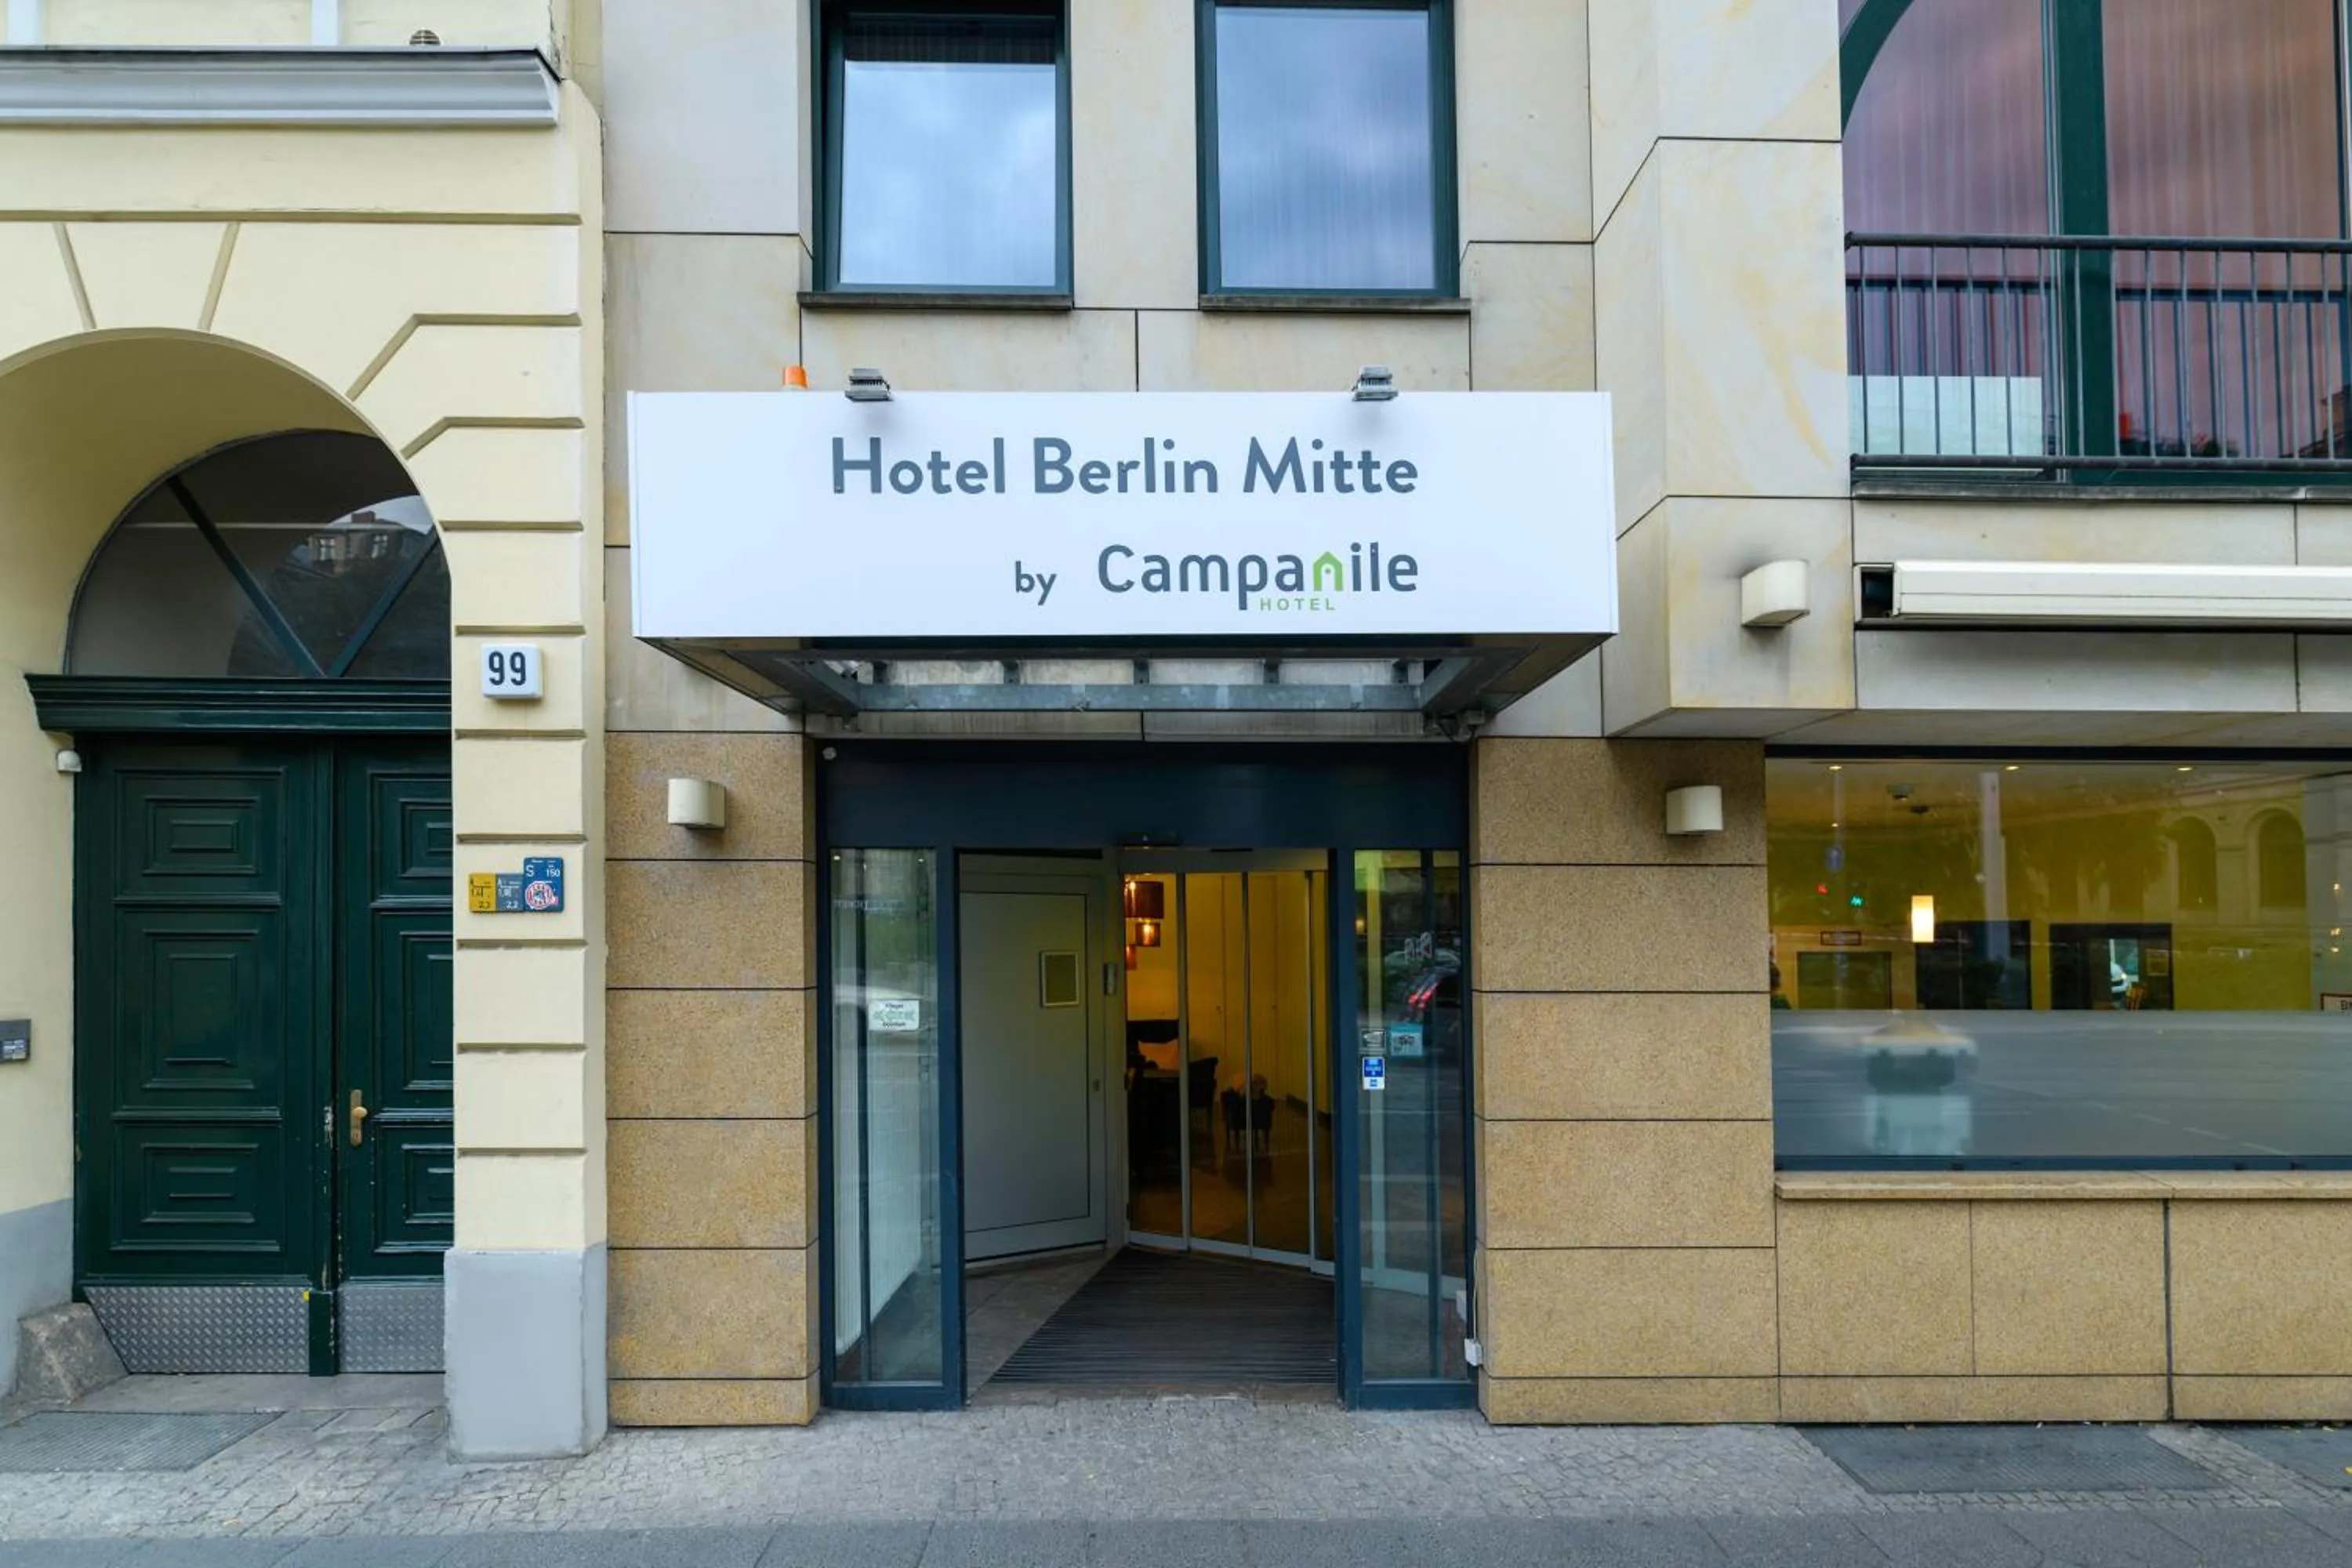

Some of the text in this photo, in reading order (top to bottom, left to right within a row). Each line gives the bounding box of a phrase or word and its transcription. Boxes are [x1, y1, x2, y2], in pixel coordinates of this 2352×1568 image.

[832, 437, 1418, 495] Hotel Berlin Mitte
[1014, 542, 1418, 612] by Campanile
[1260, 597, 1335, 612] HOTEL
[489, 652, 526, 686] 99
